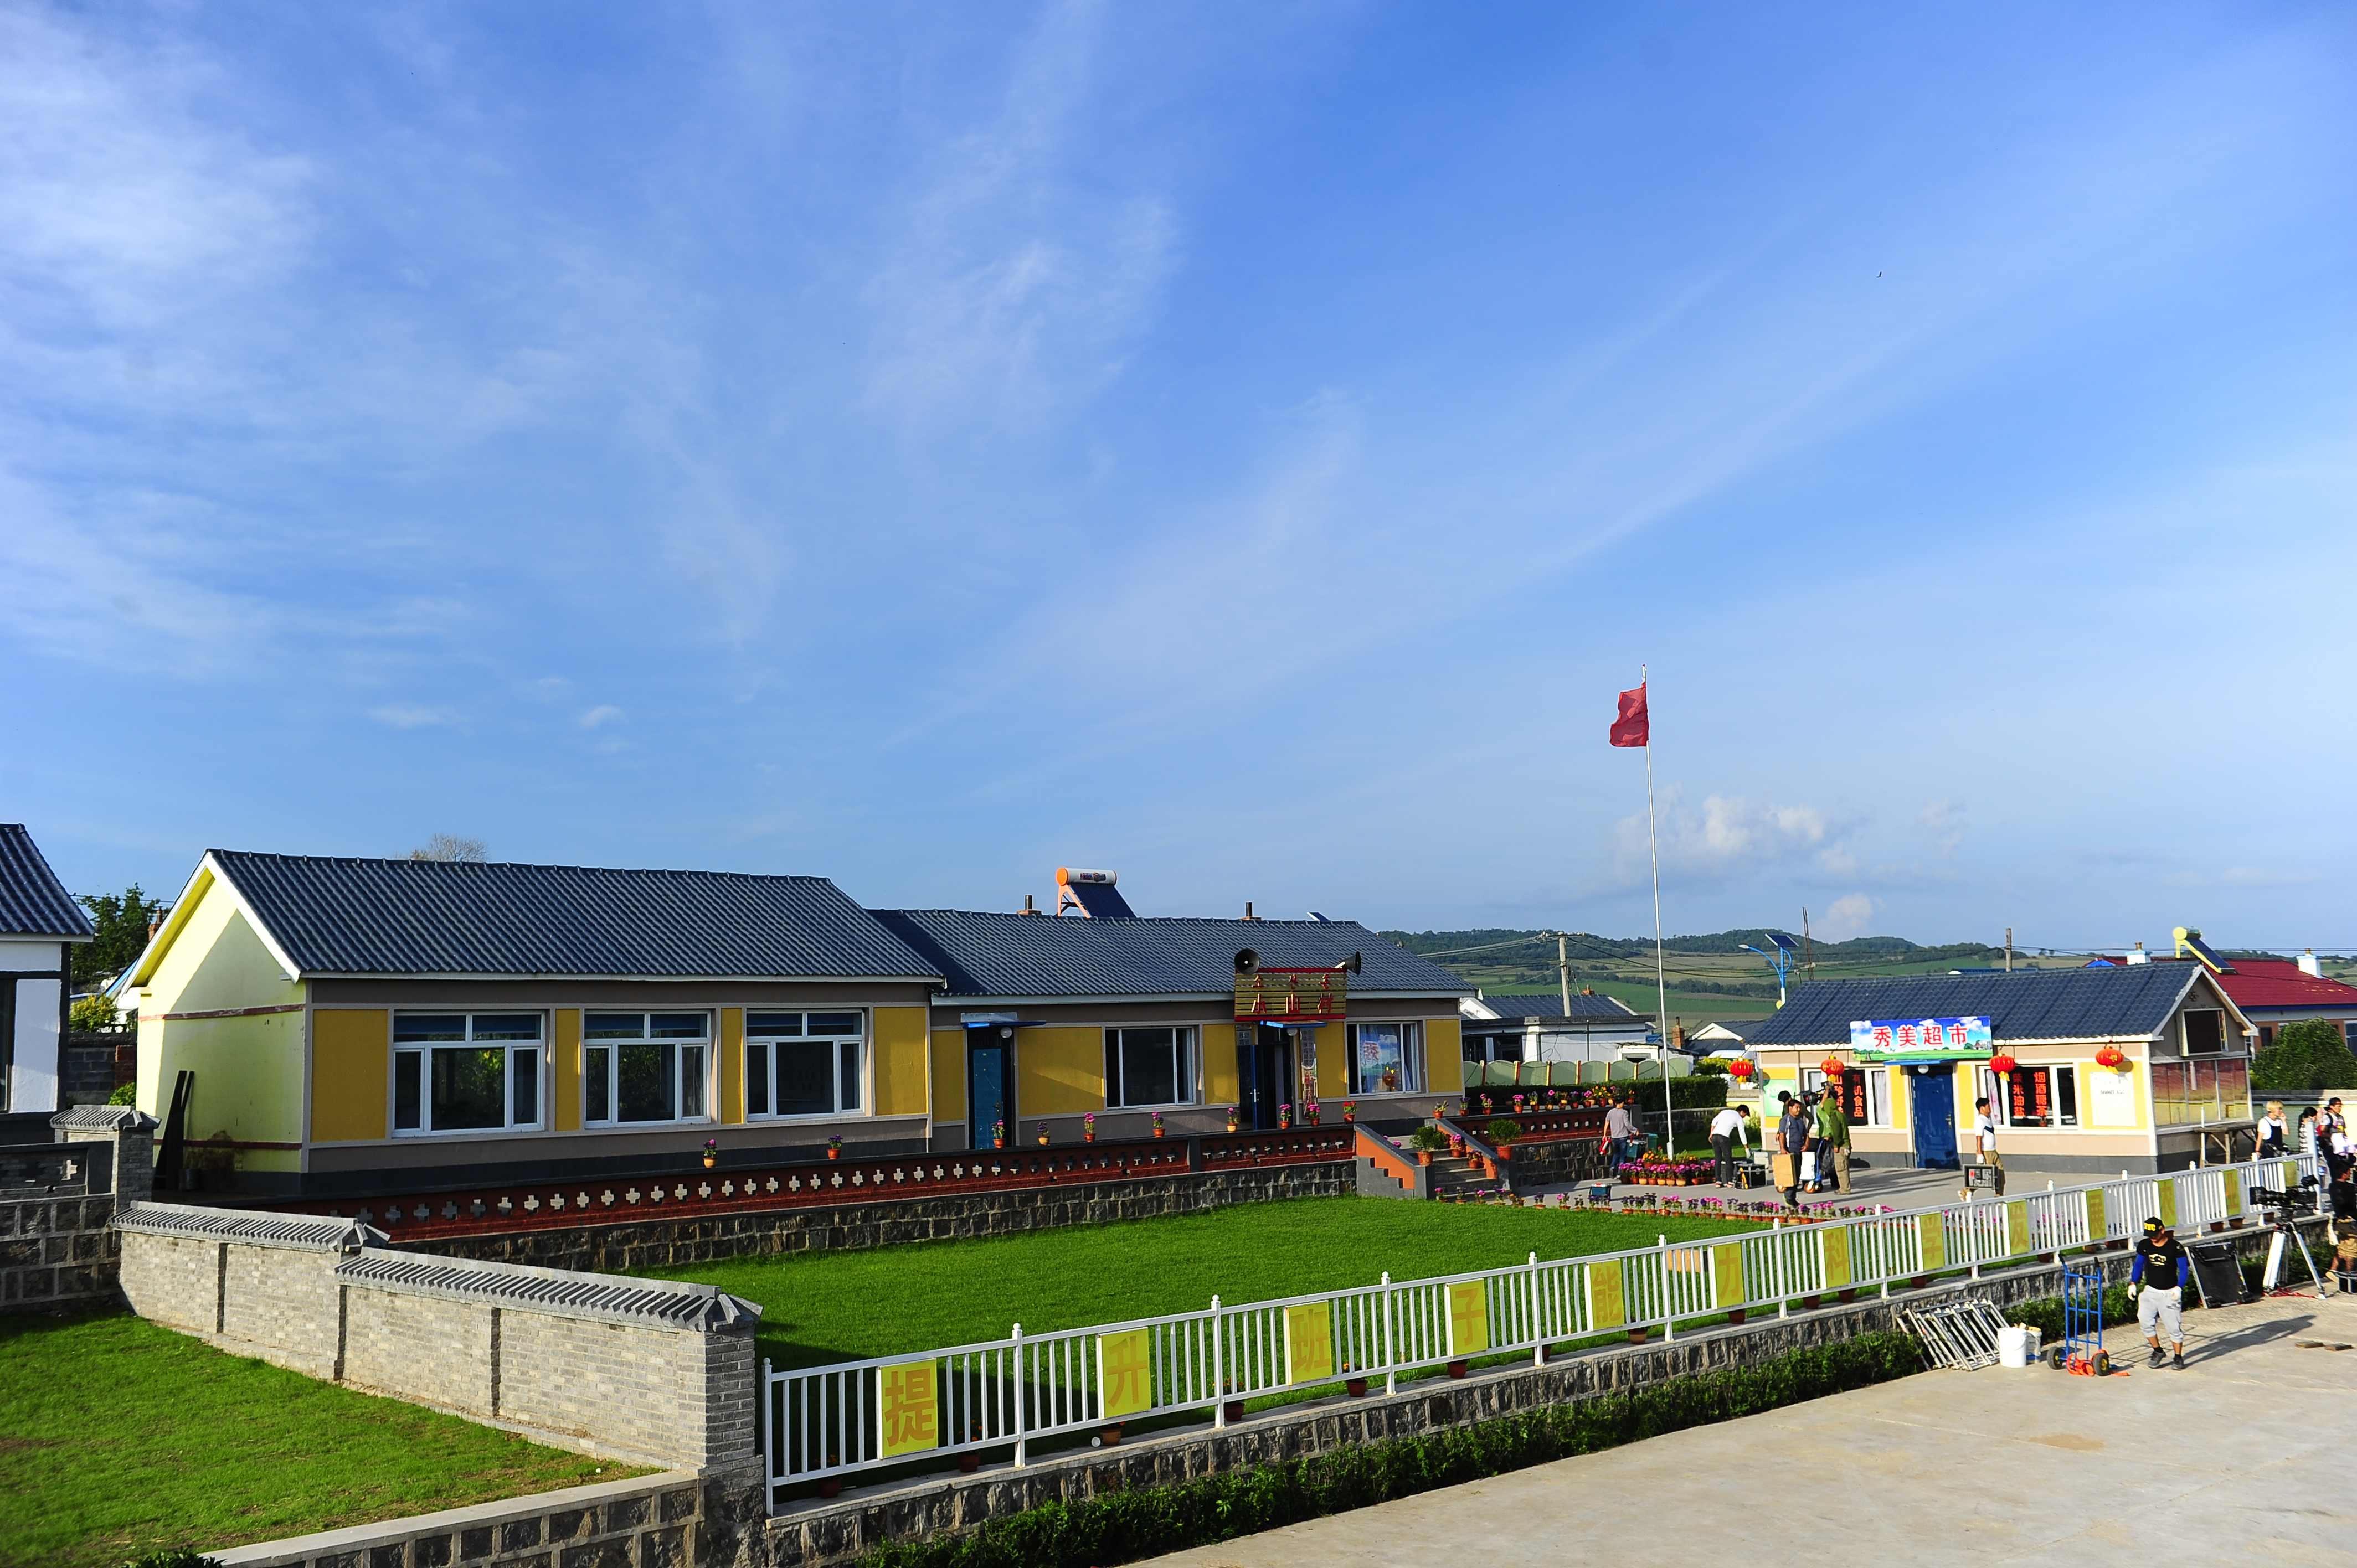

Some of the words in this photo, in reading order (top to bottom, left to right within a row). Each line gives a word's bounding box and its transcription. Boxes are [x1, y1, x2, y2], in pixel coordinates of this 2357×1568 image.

[1252, 993, 1334, 1015] 小山村
[1874, 1024, 1968, 1047] 秀美超市
[1853, 1074, 1864, 1117] 有机食品
[2013, 1073, 2025, 1117] 柴米油盐
[2034, 1072, 2047, 1116] 烟酒糖茶
[2010, 1205, 2028, 1249] 发
[2089, 1194, 2106, 1235] 展
[1825, 1230, 1849, 1280] 科
[1923, 1216, 1943, 1264] 学
[1593, 1266, 1622, 1323] 能
[1719, 1247, 1740, 1300] 力
[1291, 1308, 1331, 1374] 班
[1452, 1288, 1484, 1347] 子
[1107, 1335, 1148, 1408] 升
[884, 1368, 936, 1447] 提
